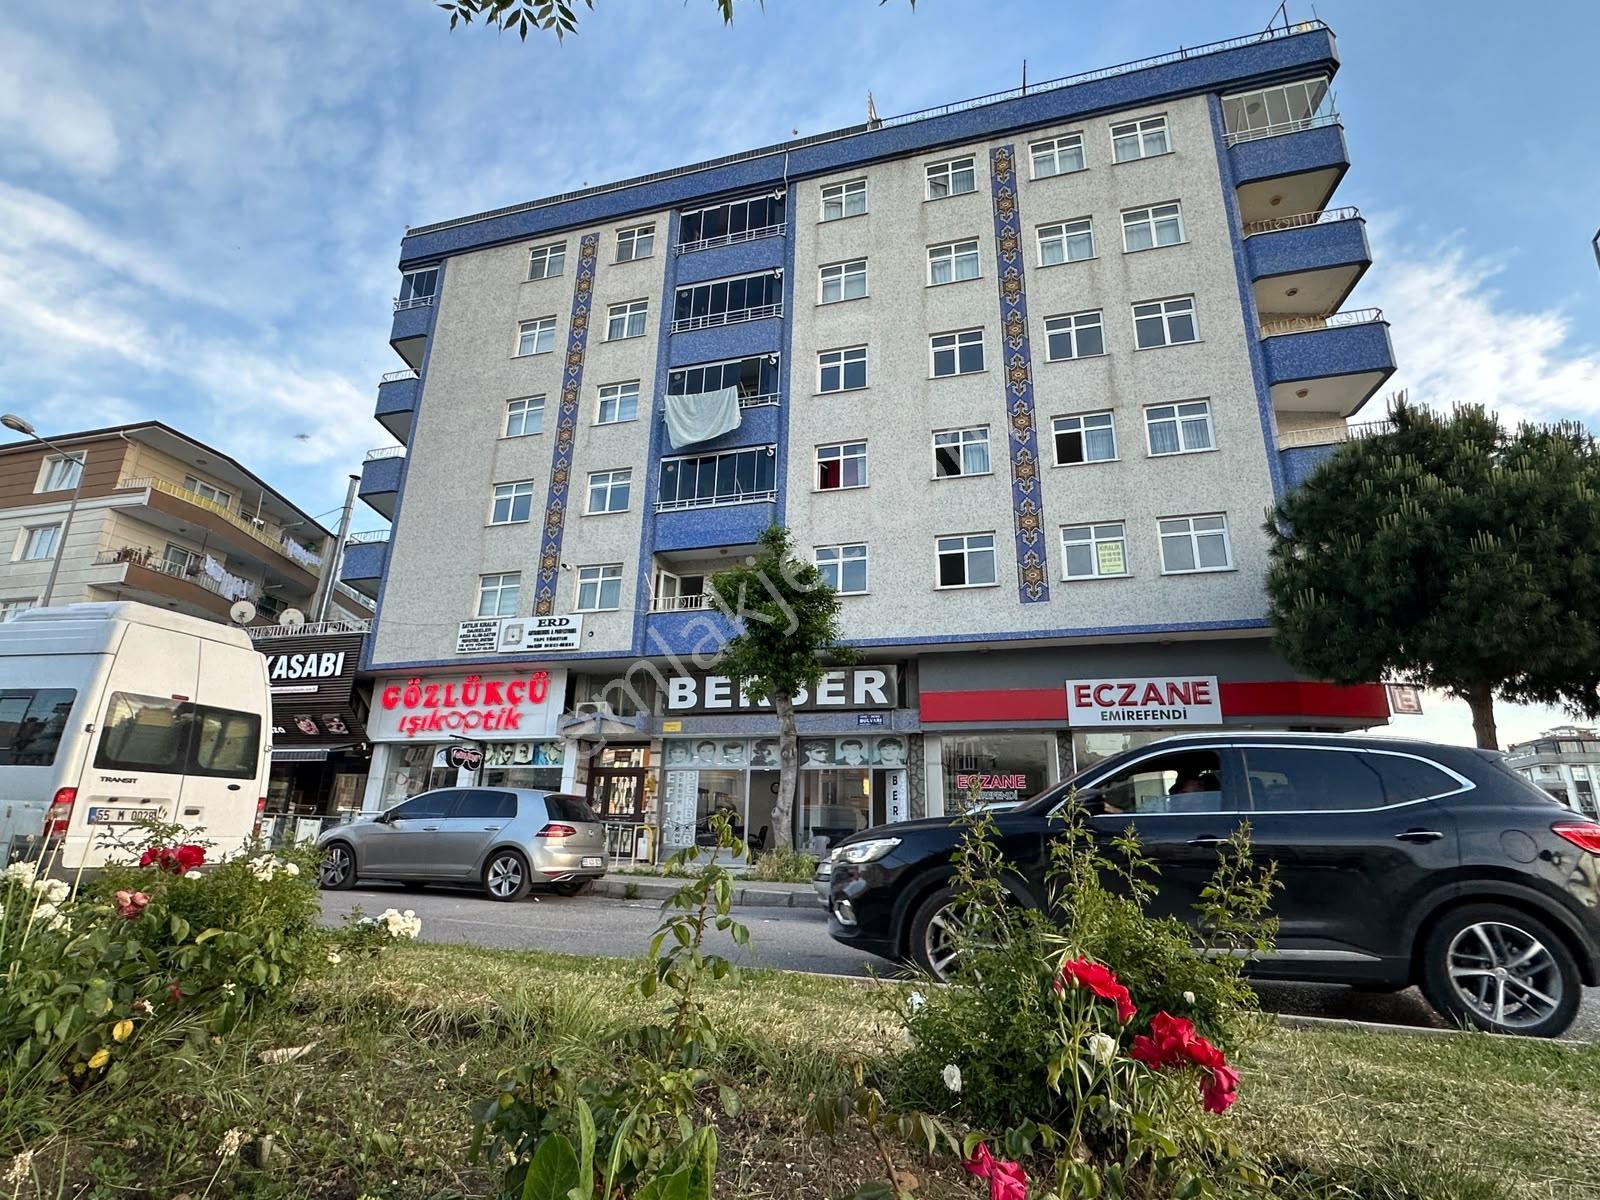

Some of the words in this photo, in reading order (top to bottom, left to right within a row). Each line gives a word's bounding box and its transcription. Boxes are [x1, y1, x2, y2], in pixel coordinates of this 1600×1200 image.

[537, 618, 570, 627] ERD
[381, 672, 549, 710] GÖZLÜKÇÜ
[1073, 681, 1212, 708] ECZANE
[1101, 707, 1187, 721] EMİREFENDİ
[100, 776, 138, 784] TRANSIT
[956, 774, 1027, 789] ECZANE
[97, 809, 110, 820] 55
[117, 810, 125, 820] M
[683, 772, 696, 844] BERBR
